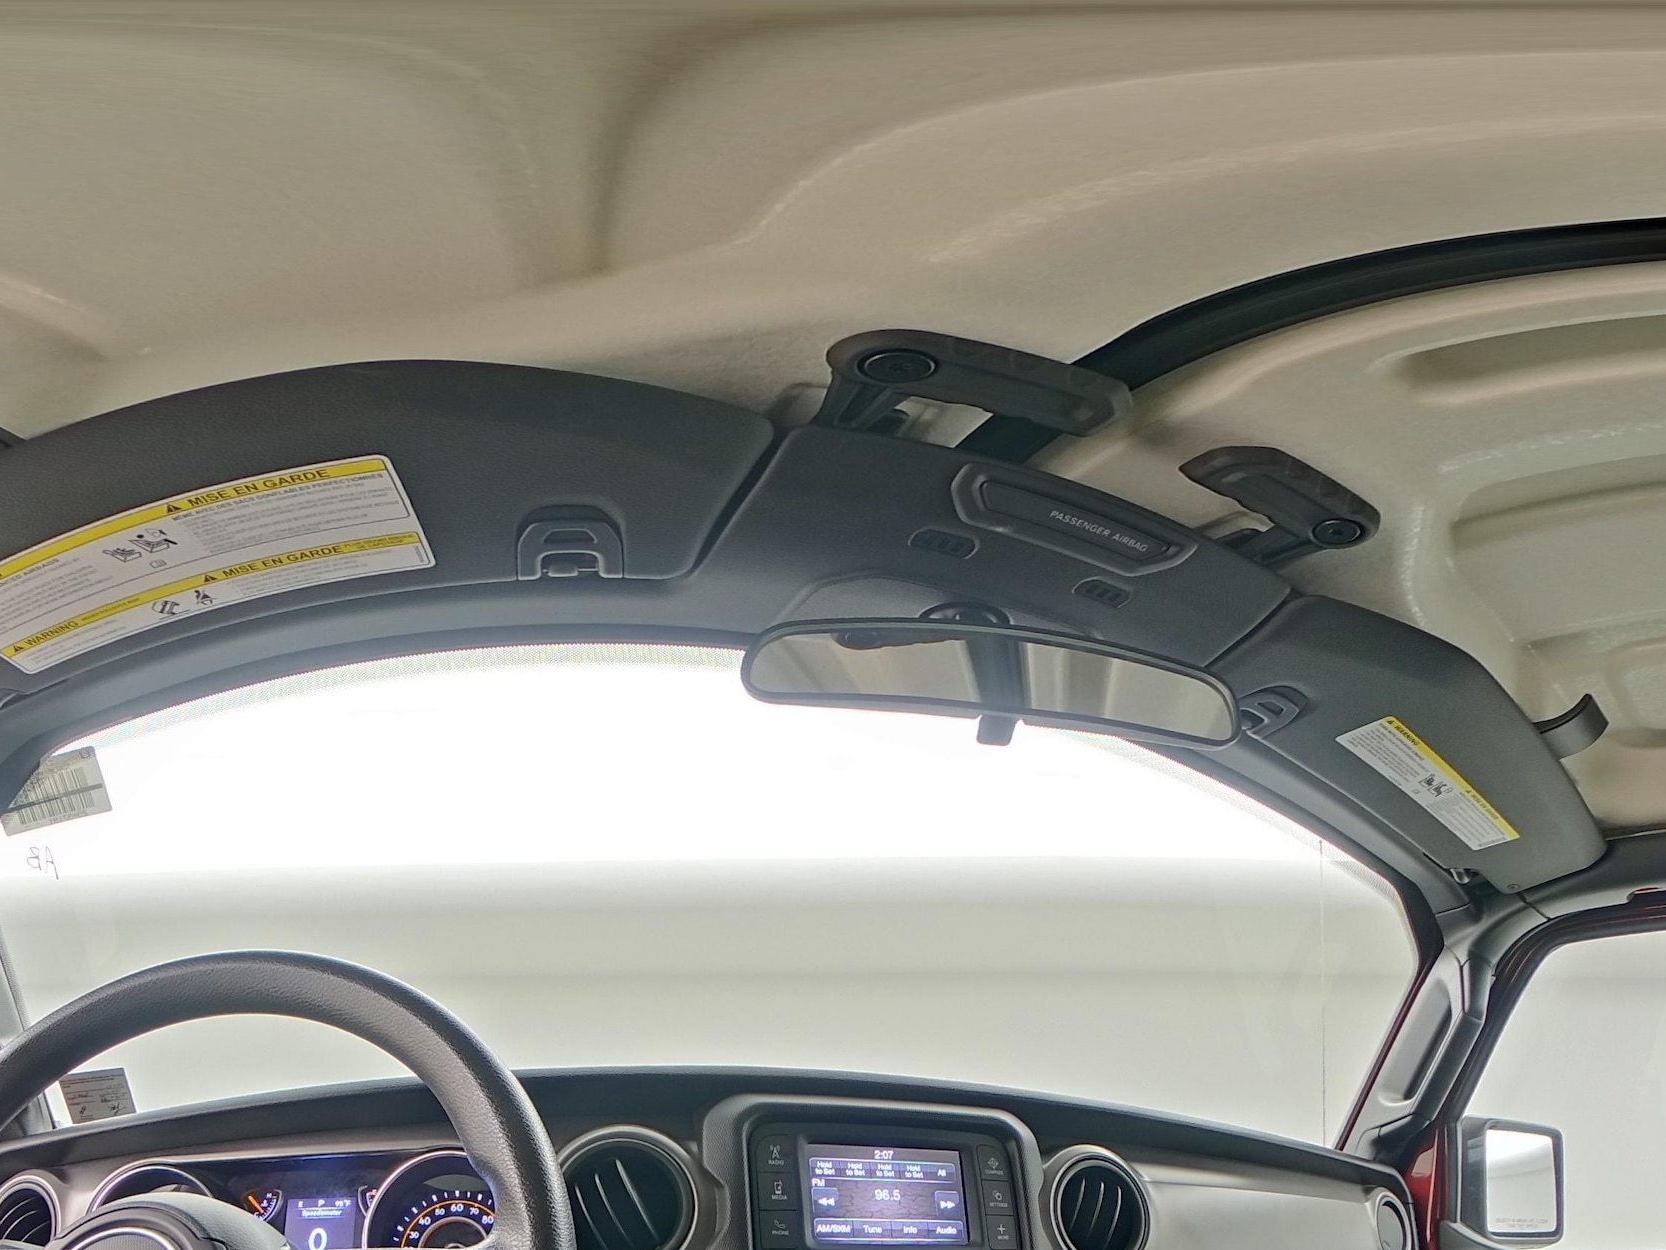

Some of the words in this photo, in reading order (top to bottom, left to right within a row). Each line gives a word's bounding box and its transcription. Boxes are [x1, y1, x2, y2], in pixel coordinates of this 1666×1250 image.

[187, 489, 231, 507] MISE
[233, 482, 259, 496] EN
[262, 469, 331, 488] GARDE
[1049, 510, 1111, 536] PASSENGER
[1112, 533, 1149, 552] AIRBAG
[221, 563, 259, 578] MISE
[261, 556, 284, 569] EN
[285, 545, 344, 563] GARDE
[24, 620, 79, 646] WARNING
[874, 1150, 894, 1160] 2:07
[823, 1168, 835, 1176] Set
[913, 1171, 924, 1179] Set
[812, 1179, 825, 1187] FM
[874, 1189, 901, 1201] 96.5
[434, 1208, 445, 1216] 50
[450, 1203, 464, 1212] 60
[469, 1207, 480, 1215] 70
[301, 1209, 343, 1218] Speedometer
[418, 1216, 431, 1225] 40
[482, 1215, 494, 1224] 80
[816, 1224, 851, 1233] AM/SXM
[863, 1225, 882, 1234] Tune
[903, 1226, 918, 1234] Info
[935, 1226, 957, 1234] Audio
[409, 1231, 420, 1239] 30
